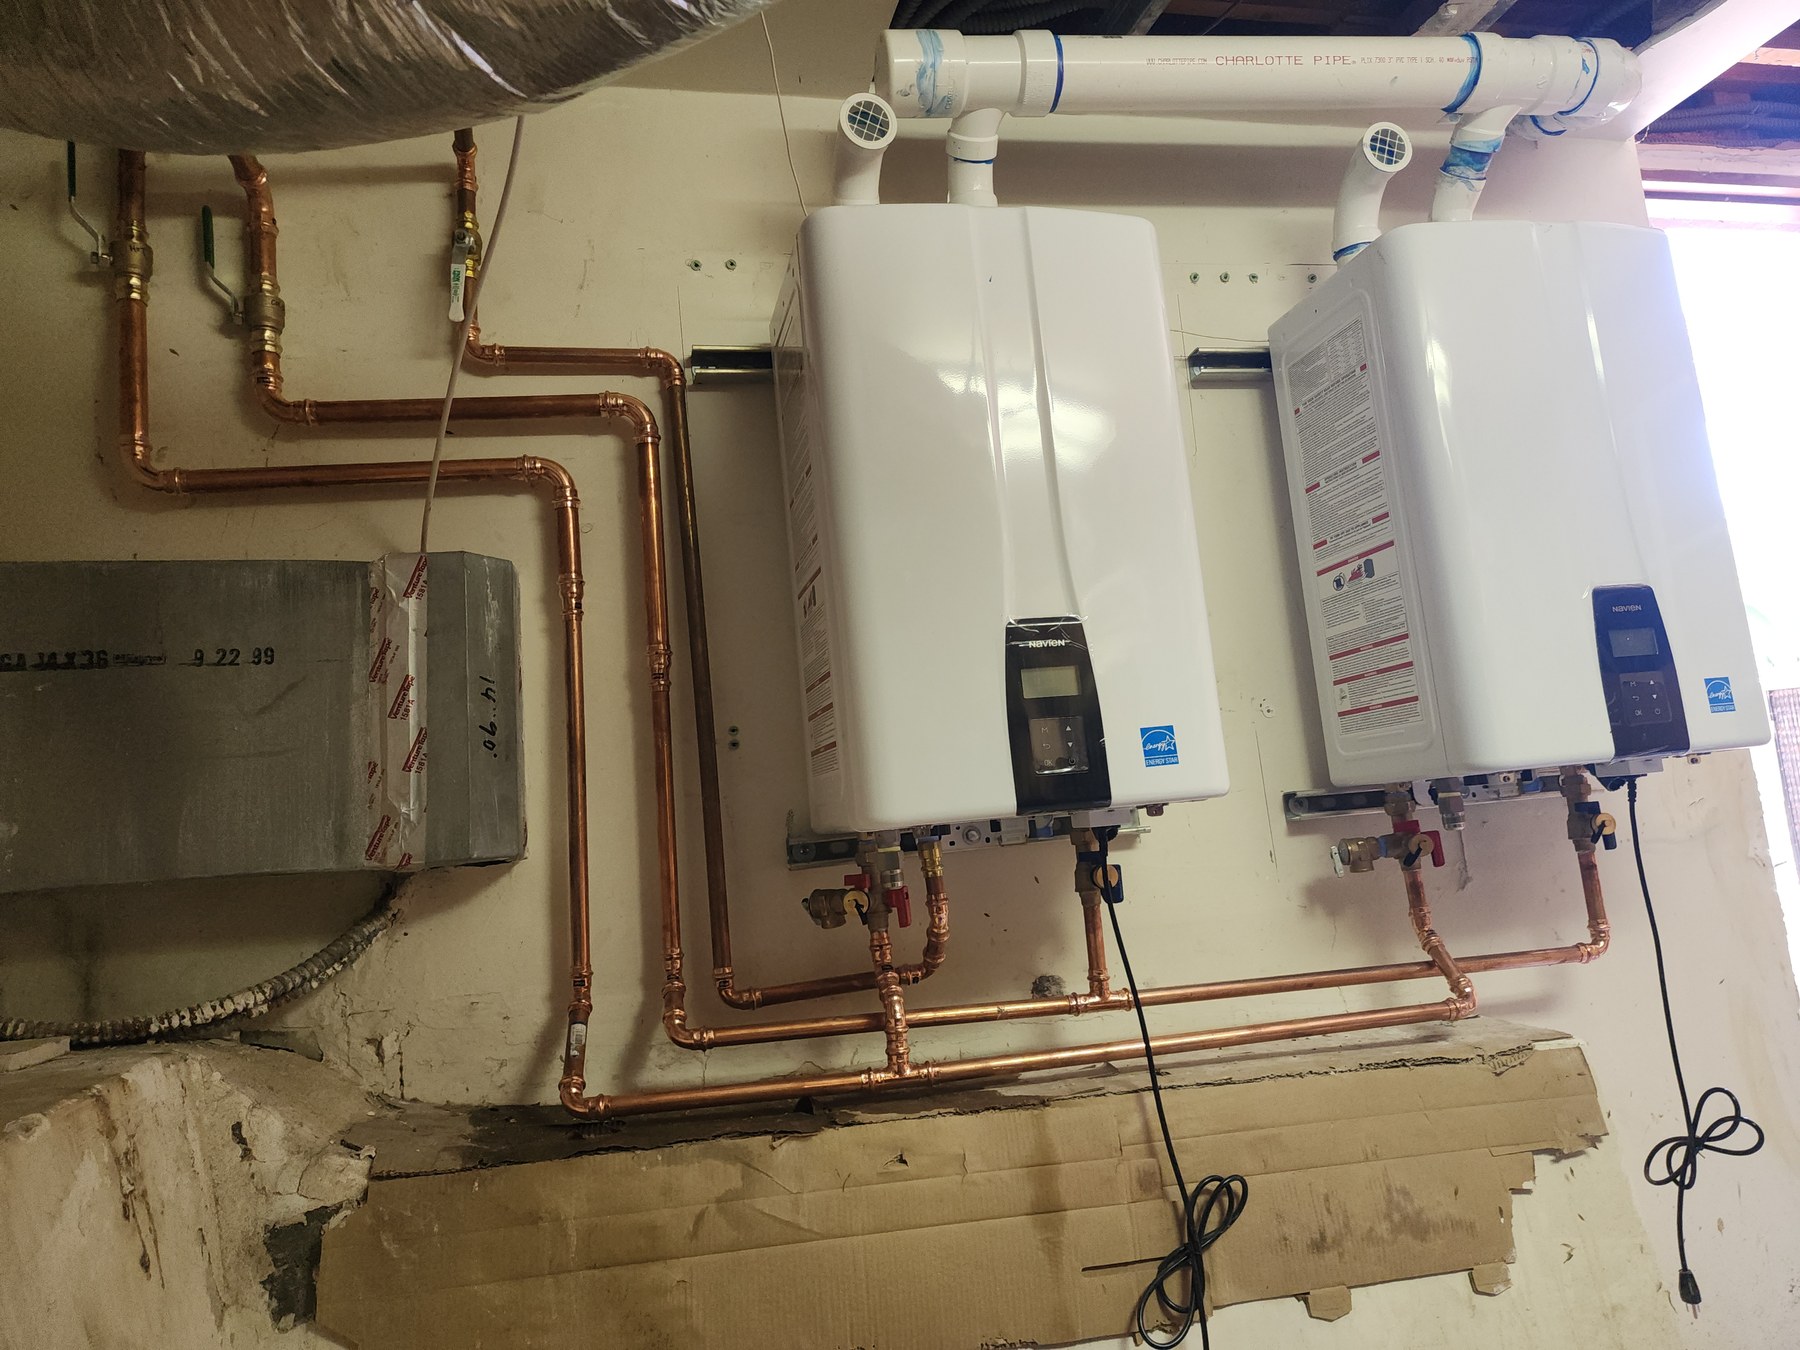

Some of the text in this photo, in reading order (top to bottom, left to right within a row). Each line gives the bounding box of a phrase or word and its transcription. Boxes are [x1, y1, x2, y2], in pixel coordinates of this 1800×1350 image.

[1215, 55, 1304, 66] CHARLOTTE
[193, 647, 275, 667] 9 22 99
[1145, 756, 1178, 766] ENERGY STAR
